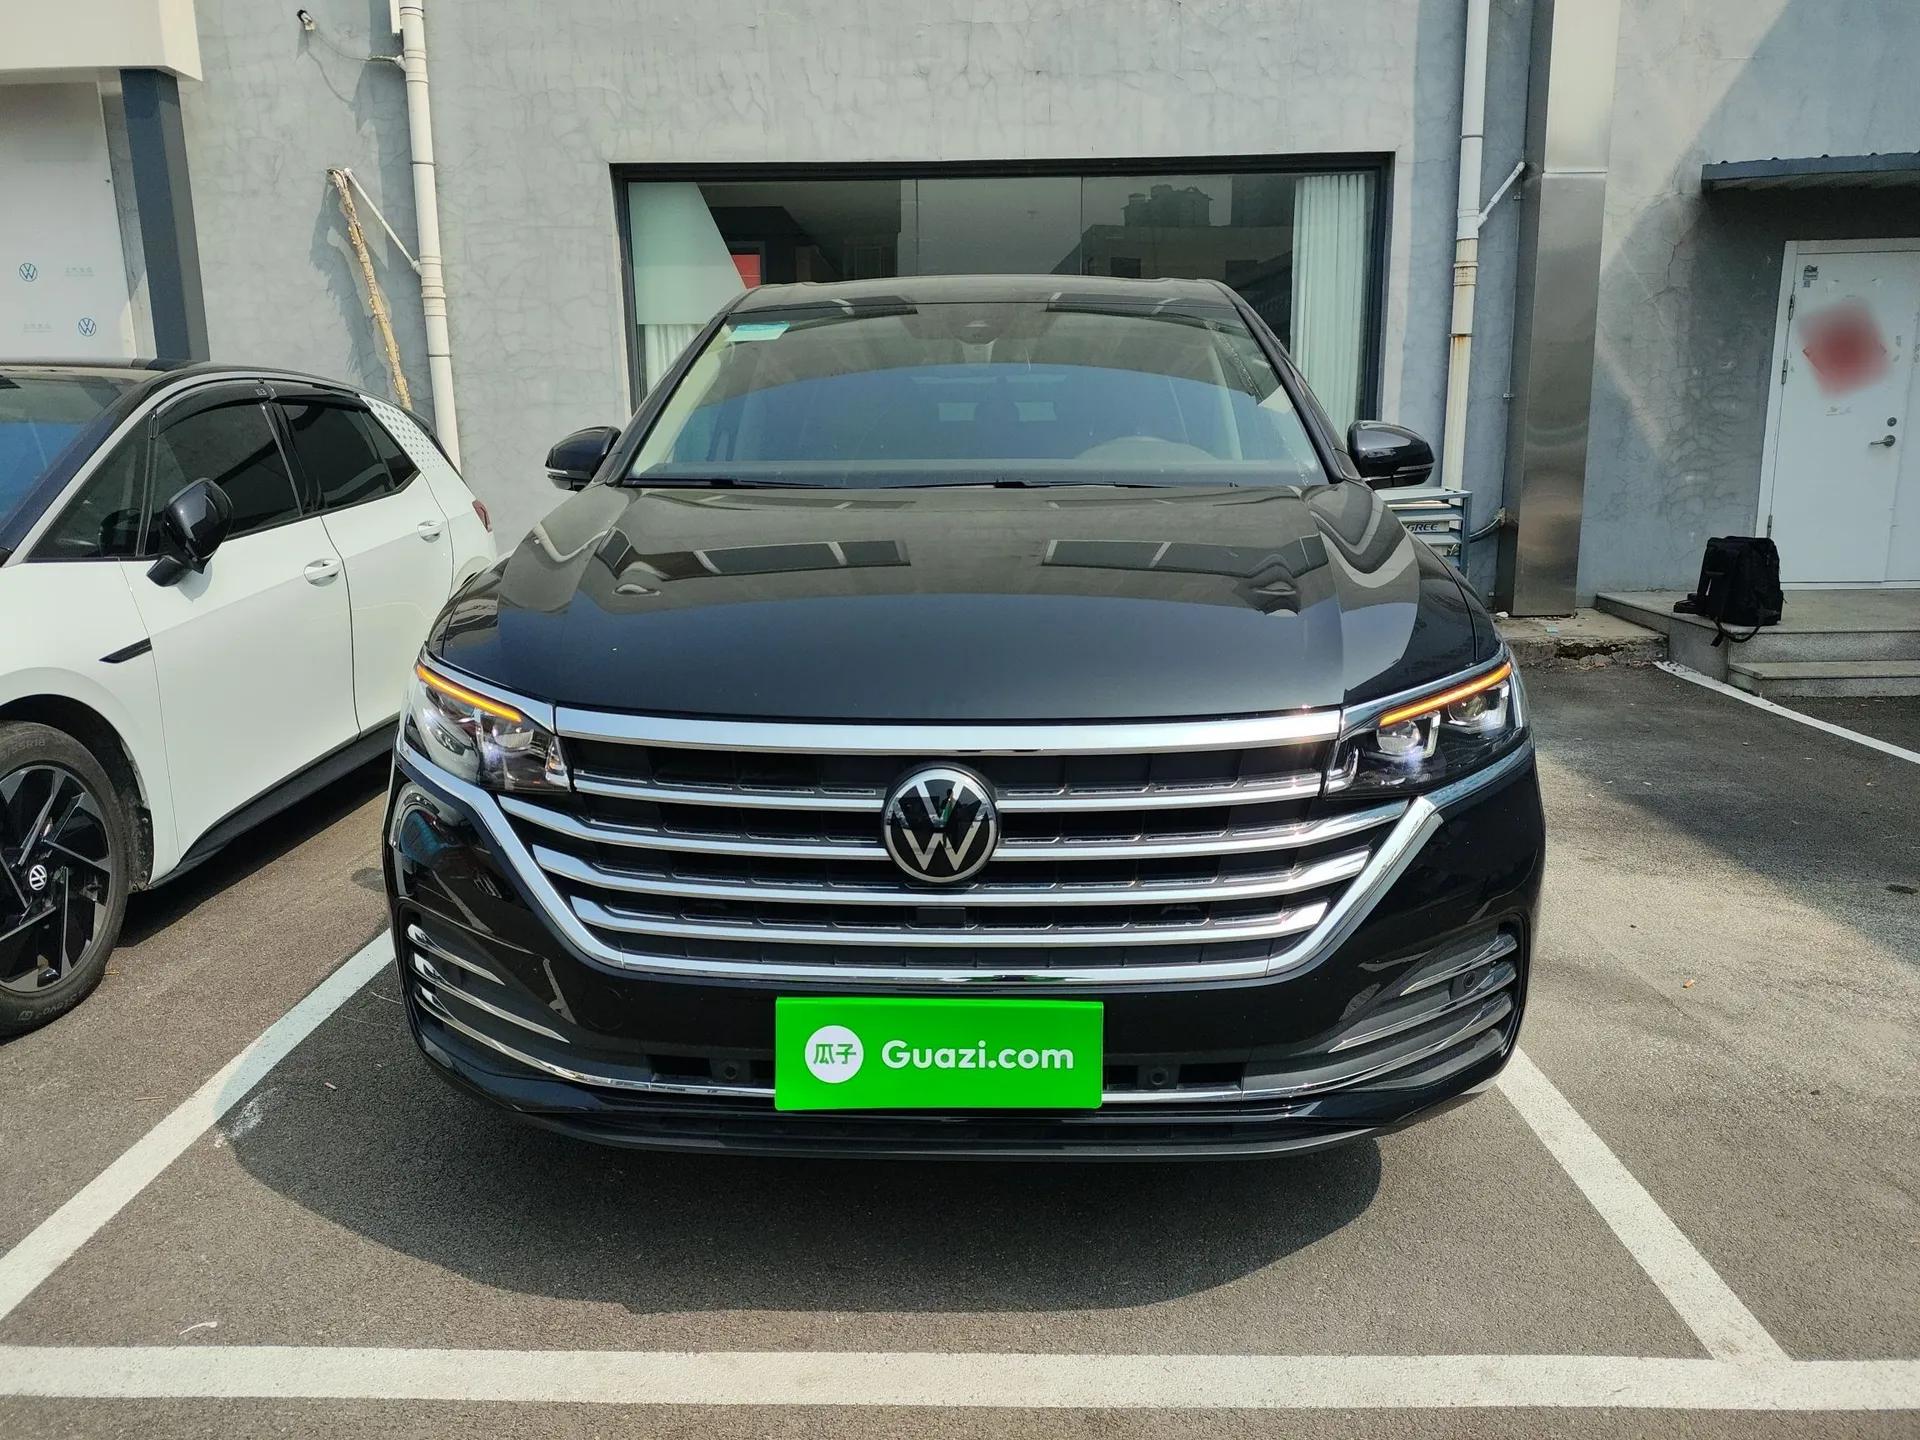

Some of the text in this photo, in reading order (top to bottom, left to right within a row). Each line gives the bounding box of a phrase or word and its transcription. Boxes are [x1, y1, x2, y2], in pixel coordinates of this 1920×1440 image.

[1406, 523, 1439, 532] GREE
[813, 1043, 857, 1065] 瓜子
[881, 1040, 1074, 1070] Guazi.com
